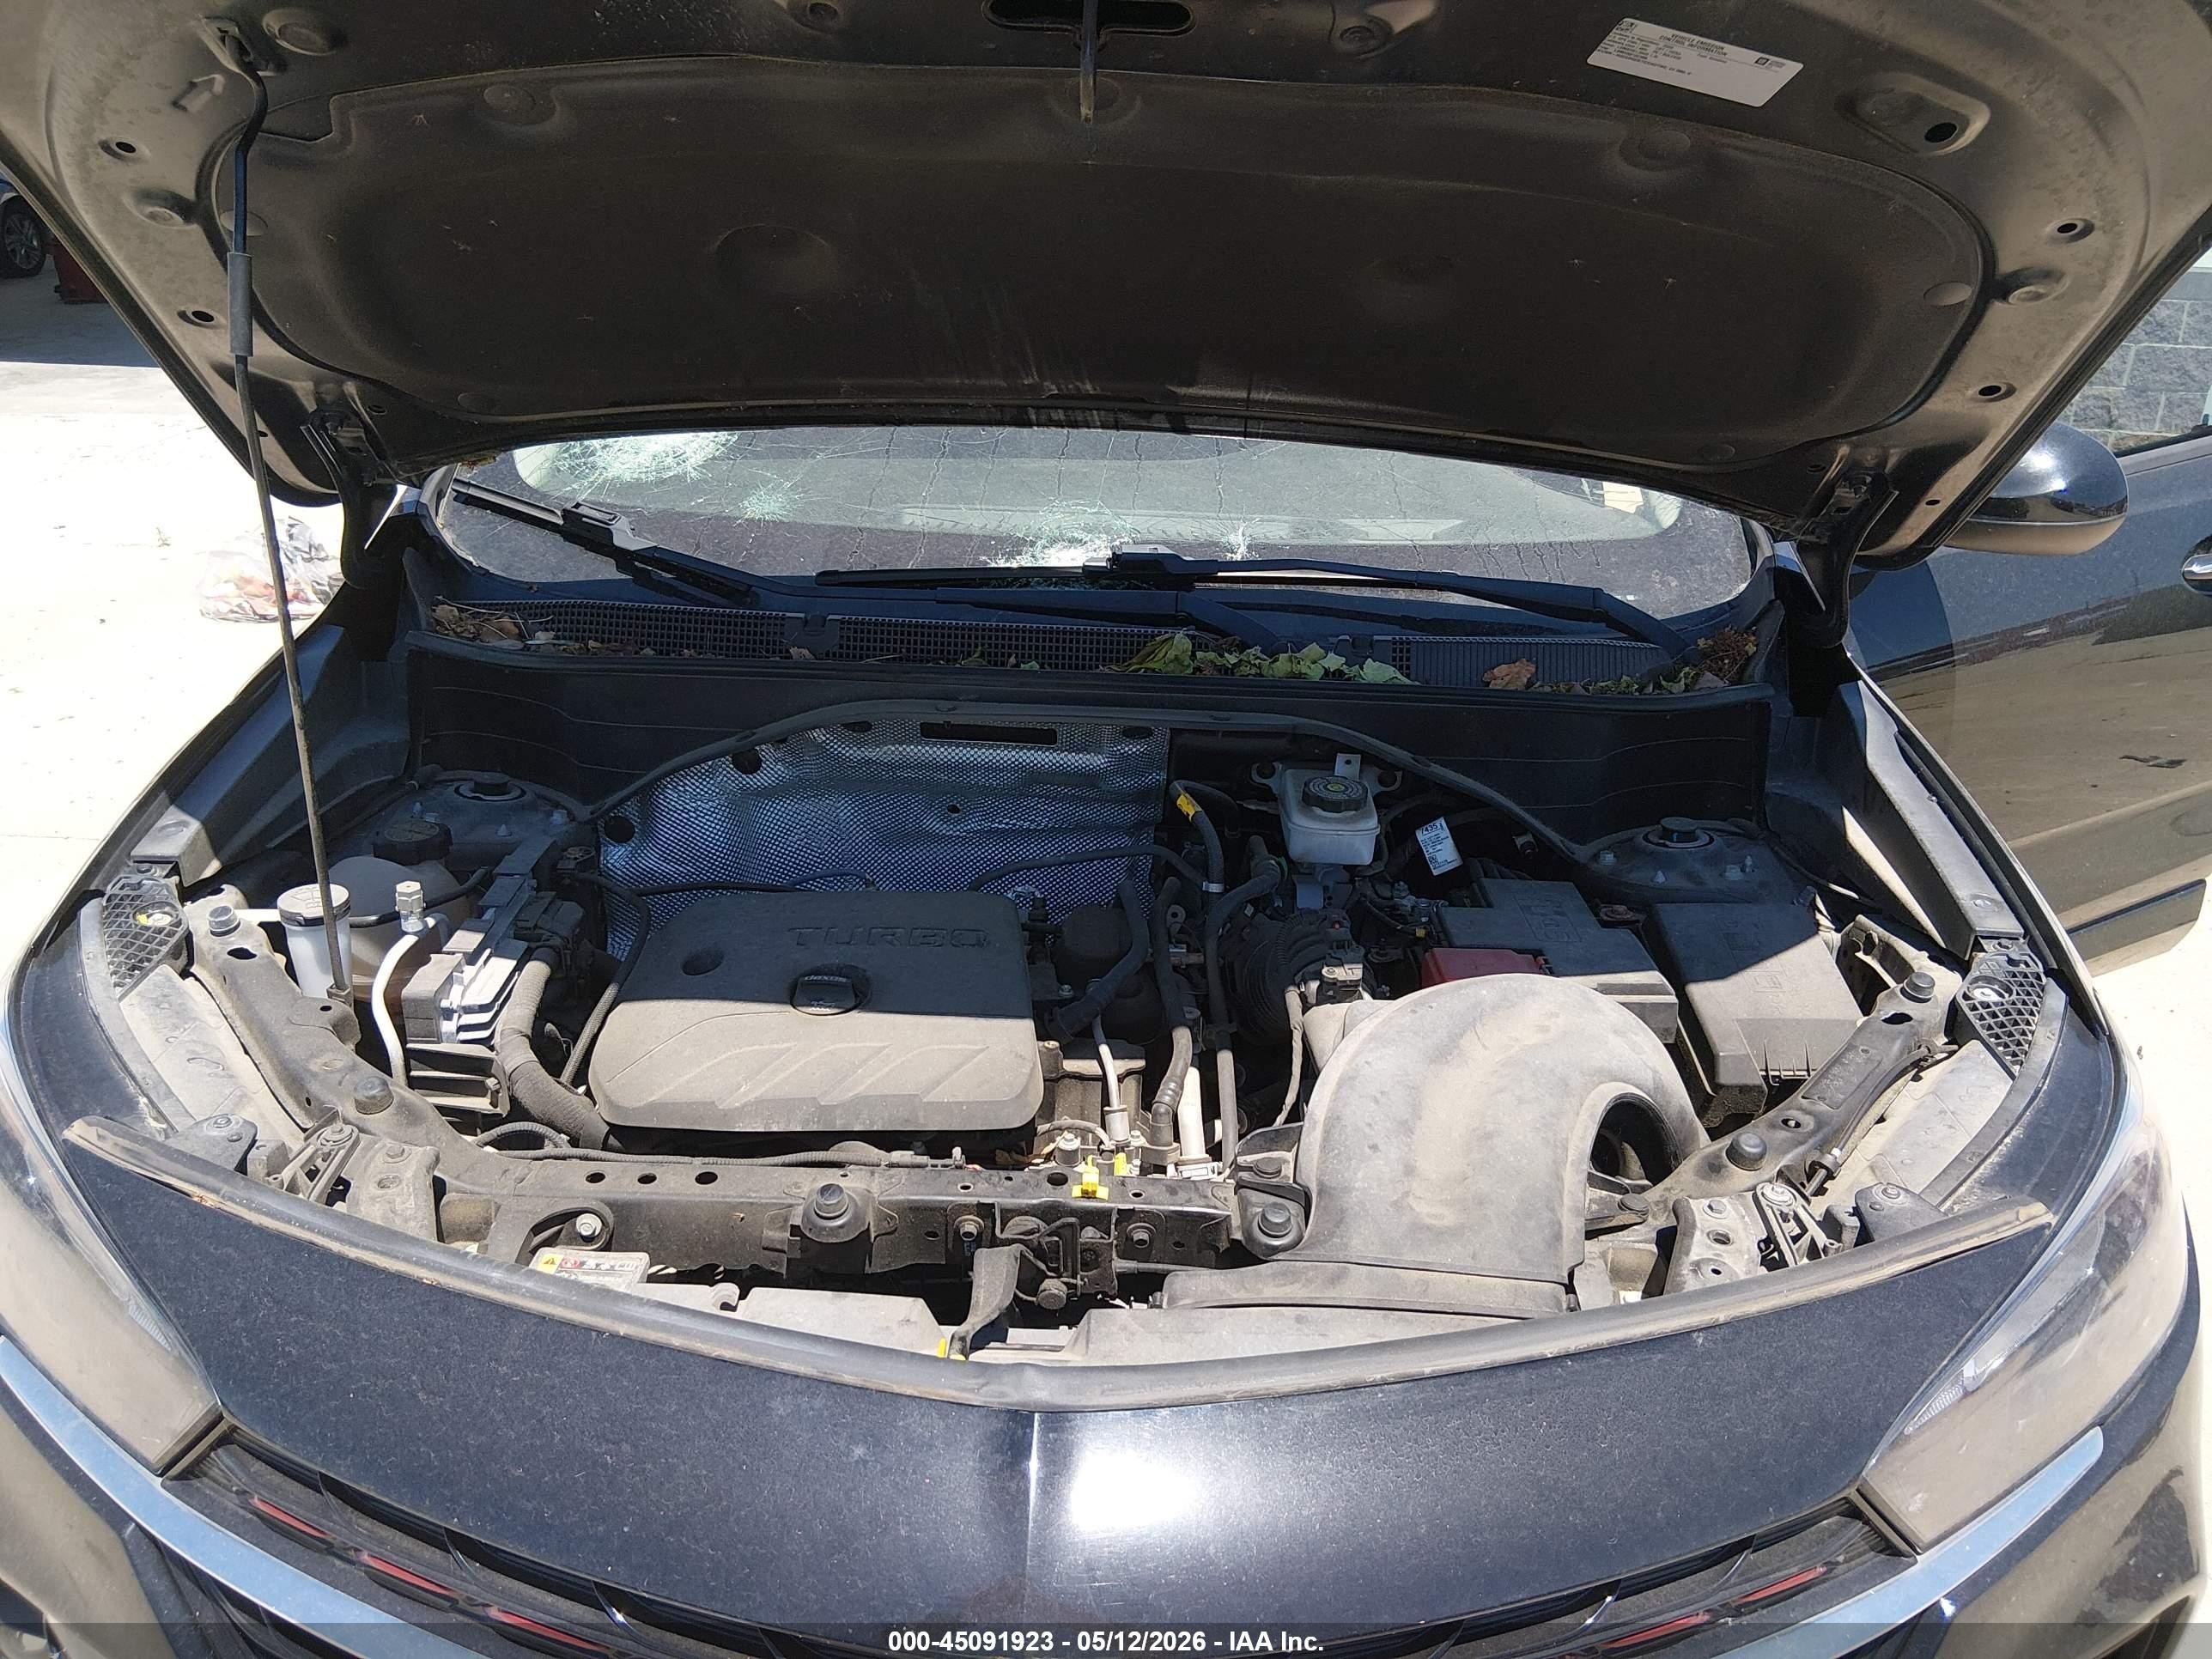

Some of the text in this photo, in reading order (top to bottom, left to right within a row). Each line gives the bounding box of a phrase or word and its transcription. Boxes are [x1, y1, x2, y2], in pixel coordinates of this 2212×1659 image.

[1659, 34, 1729, 56] CONTROL INFORMATION
[1671, 33, 1725, 51] VEHICLE EMISSION
[787, 926, 990, 948] TURBO
